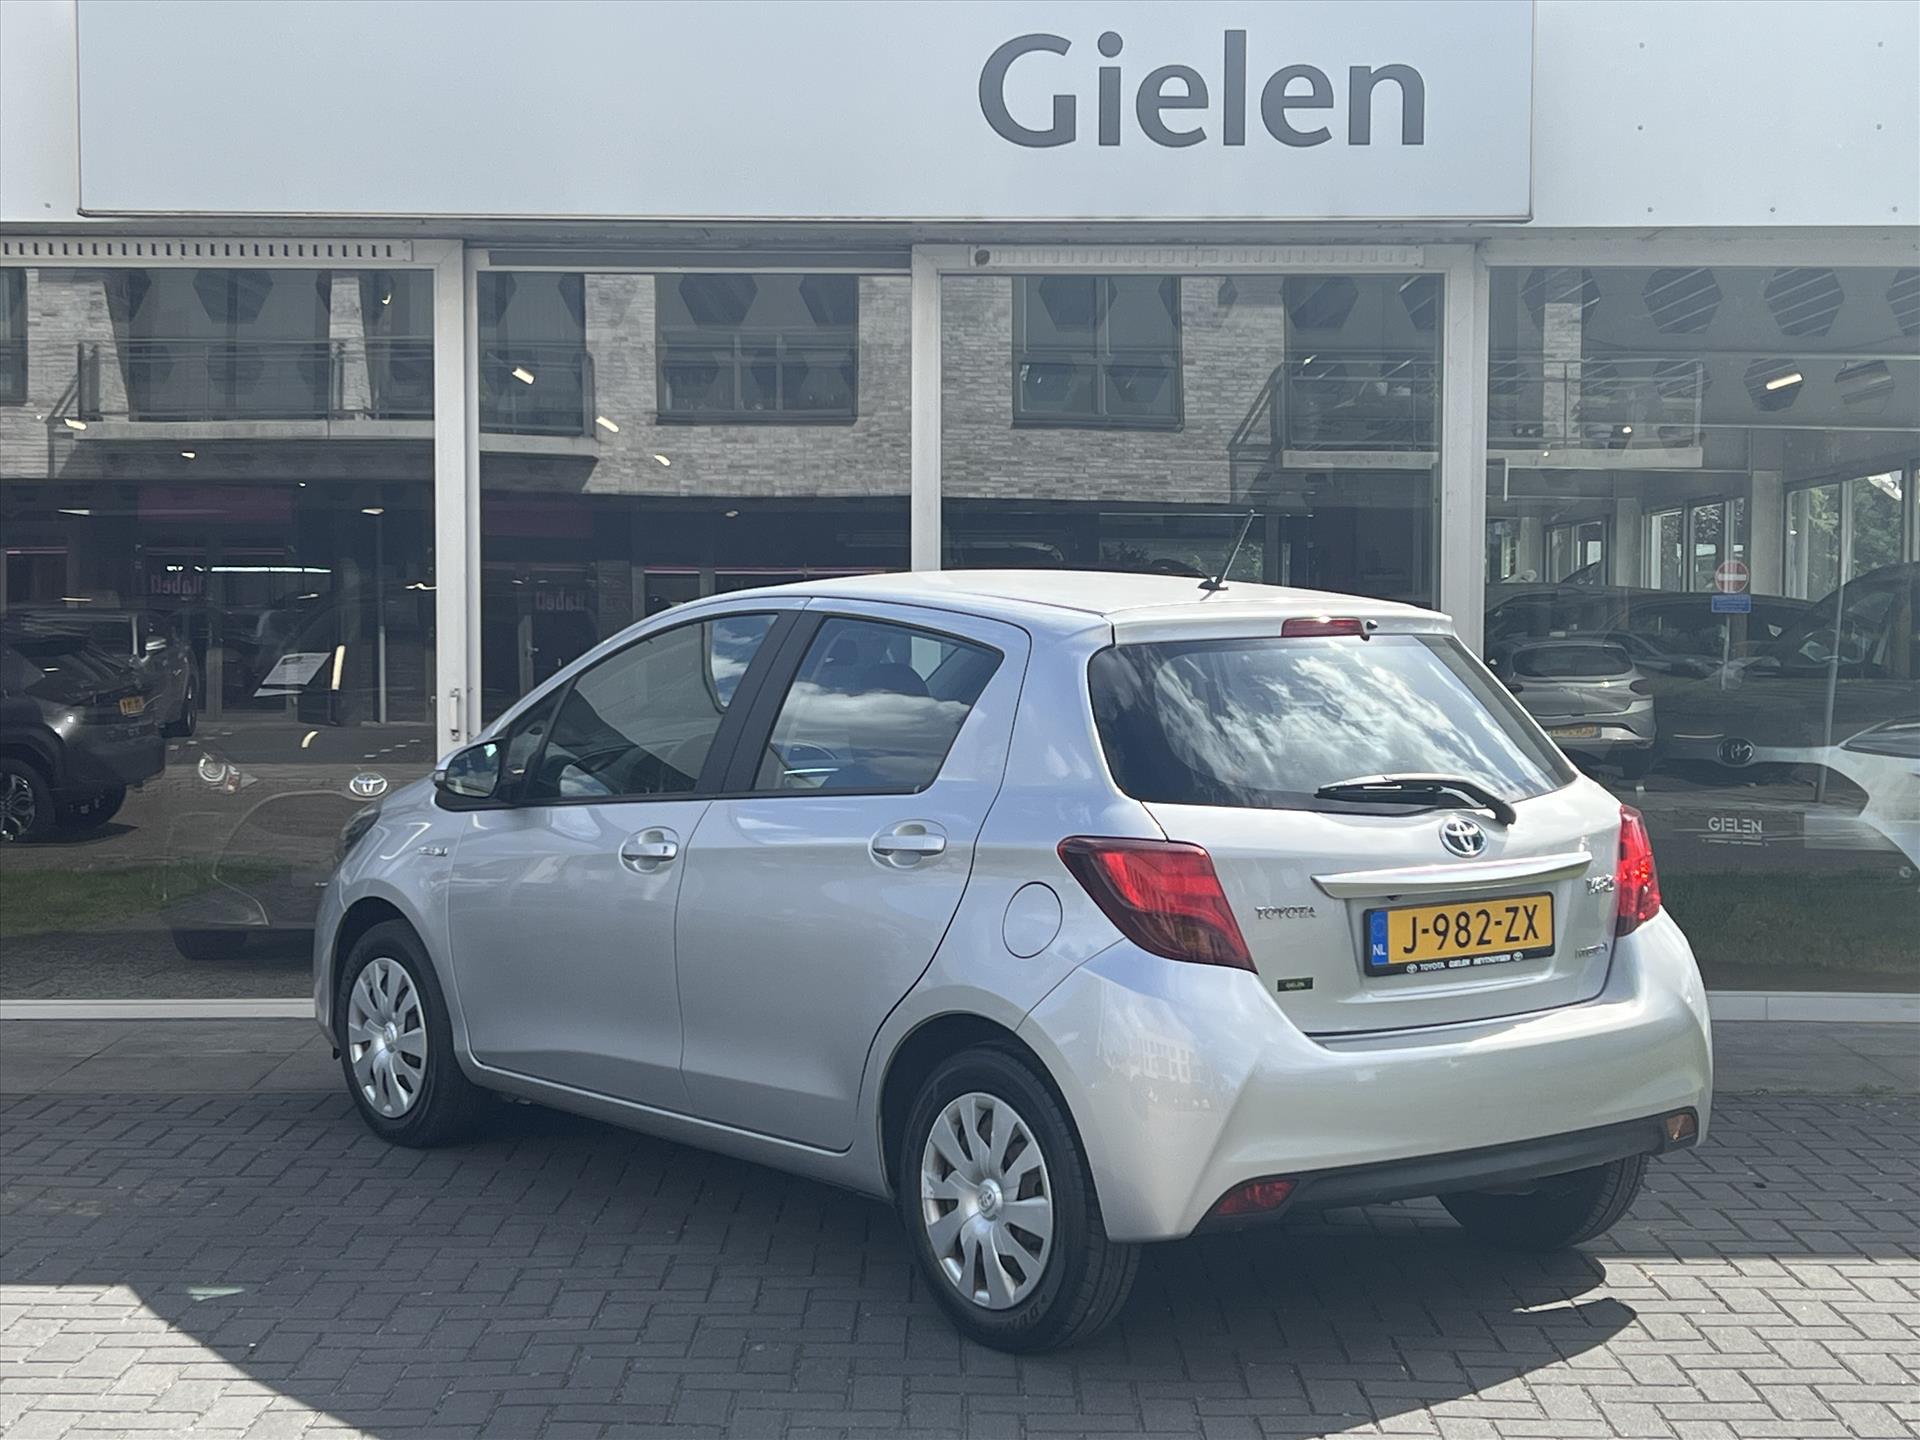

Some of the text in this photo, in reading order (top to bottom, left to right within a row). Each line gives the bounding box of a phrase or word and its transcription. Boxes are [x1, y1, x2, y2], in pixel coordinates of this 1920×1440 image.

[979, 29, 1425, 148] Gielen
[1708, 816, 1762, 833] GIELEN
[1255, 905, 1317, 920] TOYOTA
[1402, 904, 1540, 954] J-982-ZX
[1372, 943, 1387, 956] NL
[1420, 961, 1446, 972] TOYOTA
